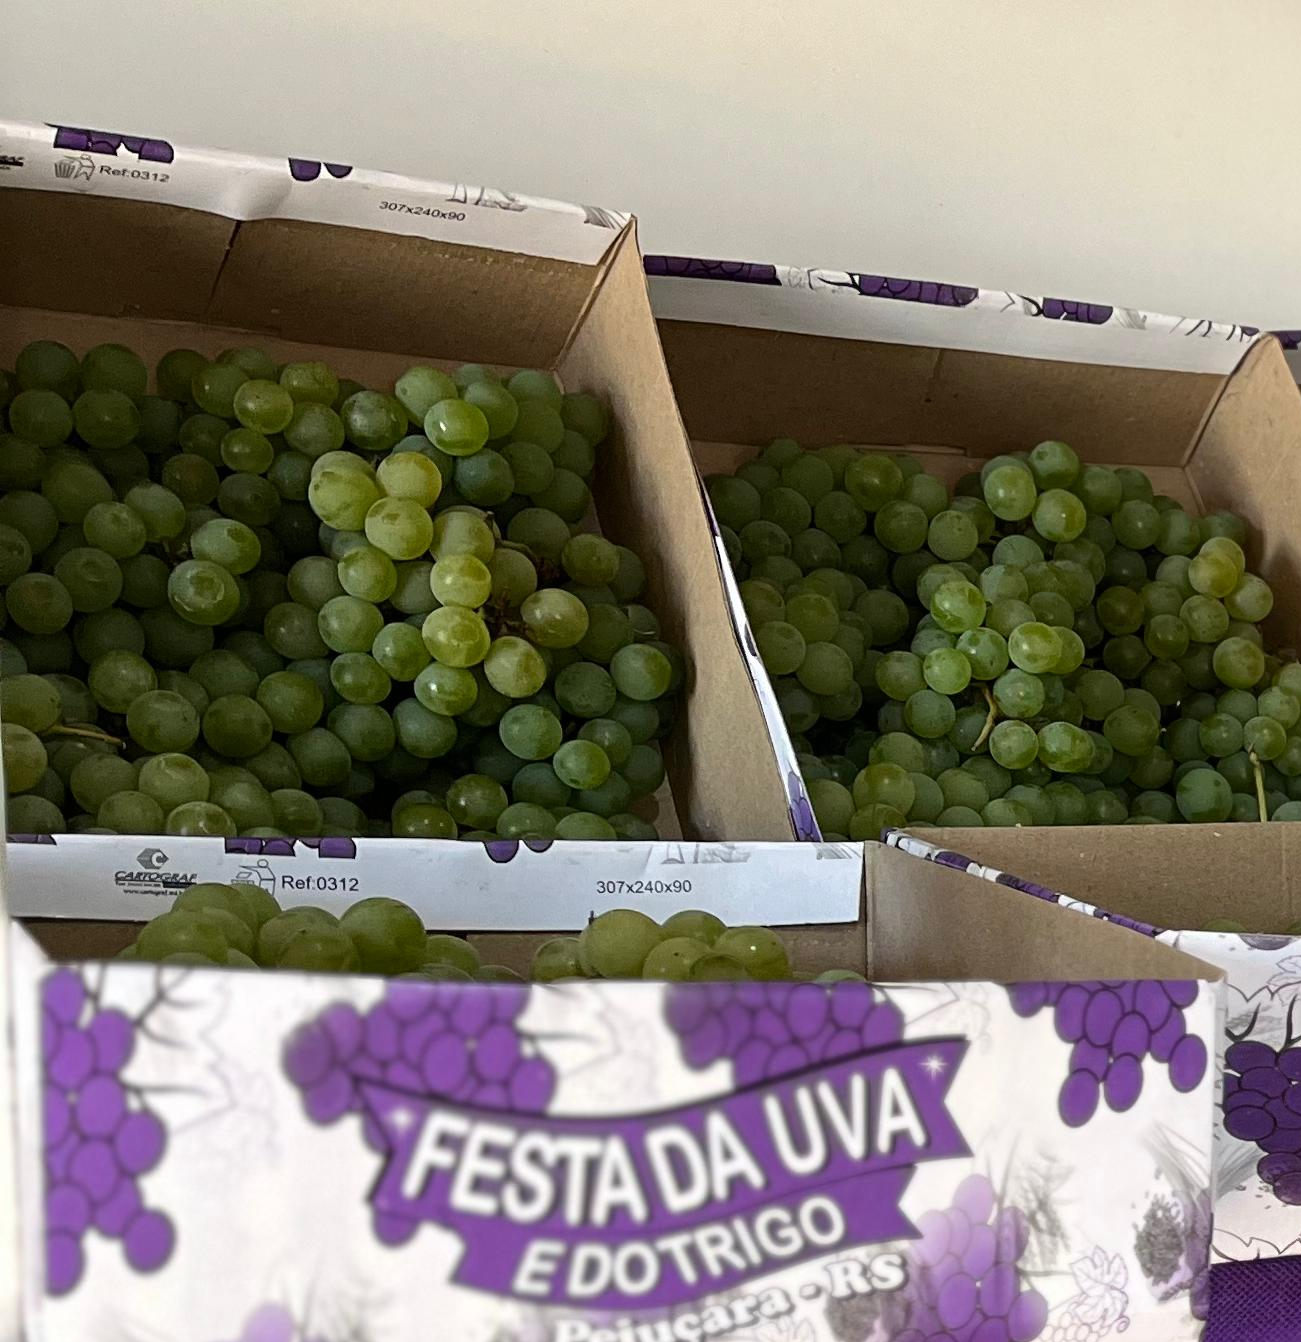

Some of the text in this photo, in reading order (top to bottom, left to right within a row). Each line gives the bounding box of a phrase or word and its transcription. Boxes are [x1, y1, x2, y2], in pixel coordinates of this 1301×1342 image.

[99, 164, 170, 183] Ref:0312
[378, 200, 466, 221] 307x240x90
[114, 870, 198, 882] CARTOGRAF
[281, 875, 359, 892] Ref:0312
[596, 879, 692, 894] 307x240x90
[400, 1067, 929, 1227] FESTA DA UVA
[513, 1195, 847, 1296] E DO TRIGO
[820, 1254, 908, 1300] RS
